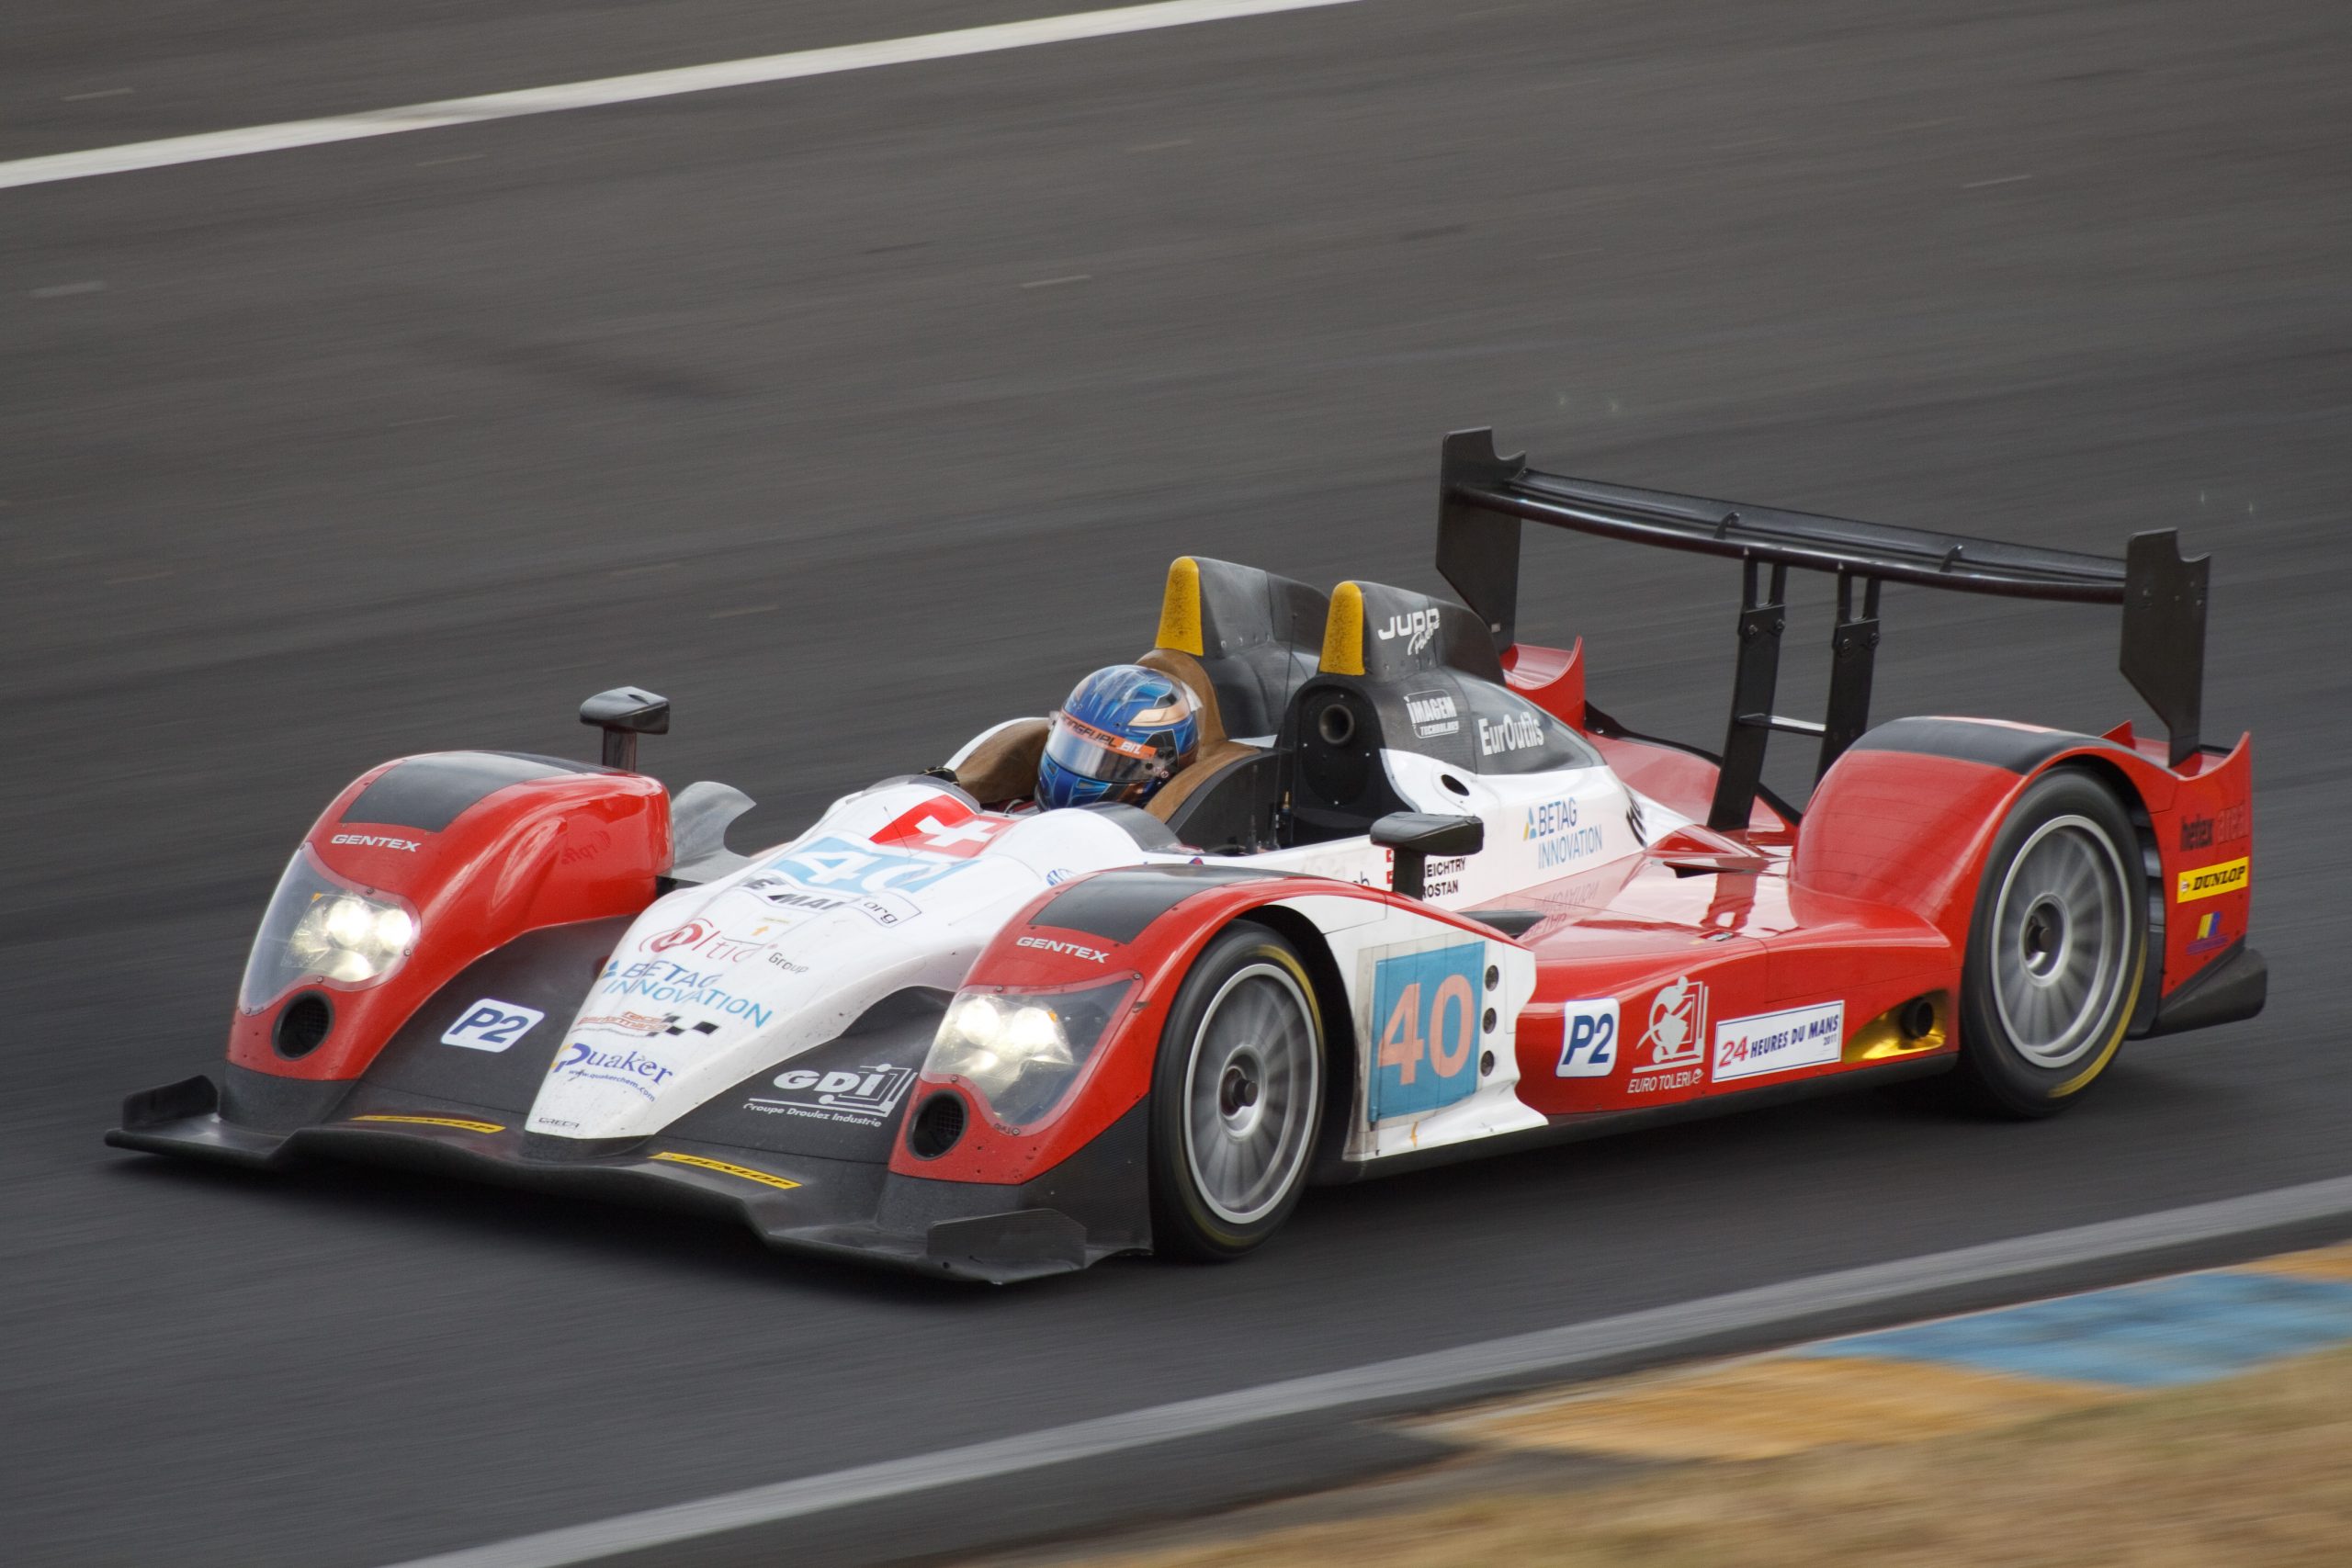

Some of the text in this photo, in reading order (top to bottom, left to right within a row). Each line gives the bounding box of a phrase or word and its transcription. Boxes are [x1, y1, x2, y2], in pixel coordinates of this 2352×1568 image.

[1377, 607, 1441, 640] JUDD
[1477, 711, 1544, 756] EurOutils
[1538, 797, 1577, 837] BETAG
[331, 834, 422, 852] GENTEX
[1538, 824, 1602, 869] INNOVATION
[1425, 857, 1467, 878] EICHTRY
[2193, 865, 2246, 891] DUNLOP
[768, 952, 809, 975] Group
[1015, 937, 1110, 964] GENTEX
[621, 960, 724, 988] BETAG
[603, 978, 774, 1030] INNOVATION
[448, 1007, 529, 1043] P2
[1377, 974, 1476, 1086] 40
[1561, 1013, 1614, 1066] P2
[1718, 1014, 1839, 1069] 24 HEURES DU MANS
[550, 1043, 673, 1086] Quaker
[568, 1069, 658, 1102] www.quakerchem.com
[1626, 1077, 1660, 1094] EURO
[786, 1108, 830, 1121] Droulez
[832, 1113, 882, 1128] Industrie
